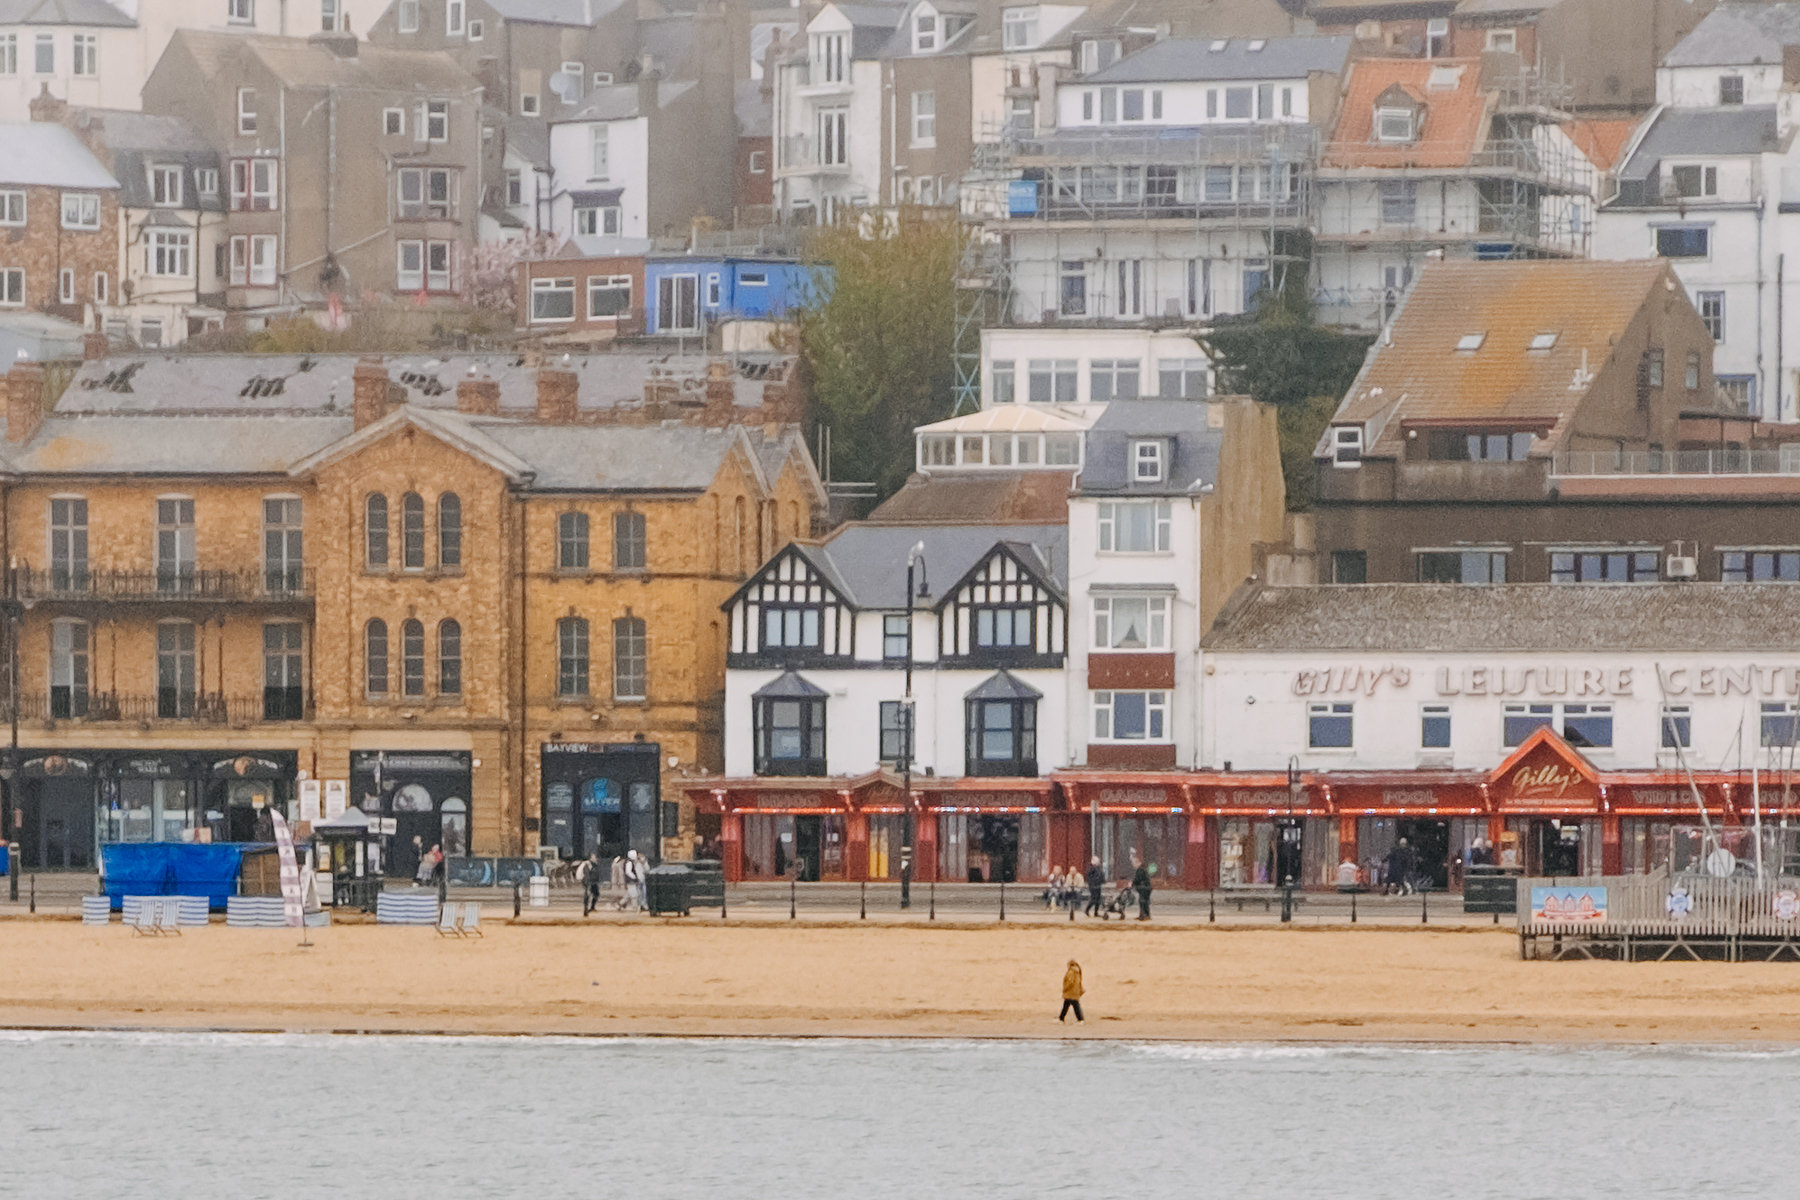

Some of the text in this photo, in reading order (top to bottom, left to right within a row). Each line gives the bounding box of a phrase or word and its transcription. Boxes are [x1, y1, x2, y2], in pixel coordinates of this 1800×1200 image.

[1436, 666, 1633, 696] LEISURE
[546, 744, 588, 753] BAYVIEW
[1512, 765, 1582, 797] Gilly's
[1383, 791, 1438, 804] POOL
